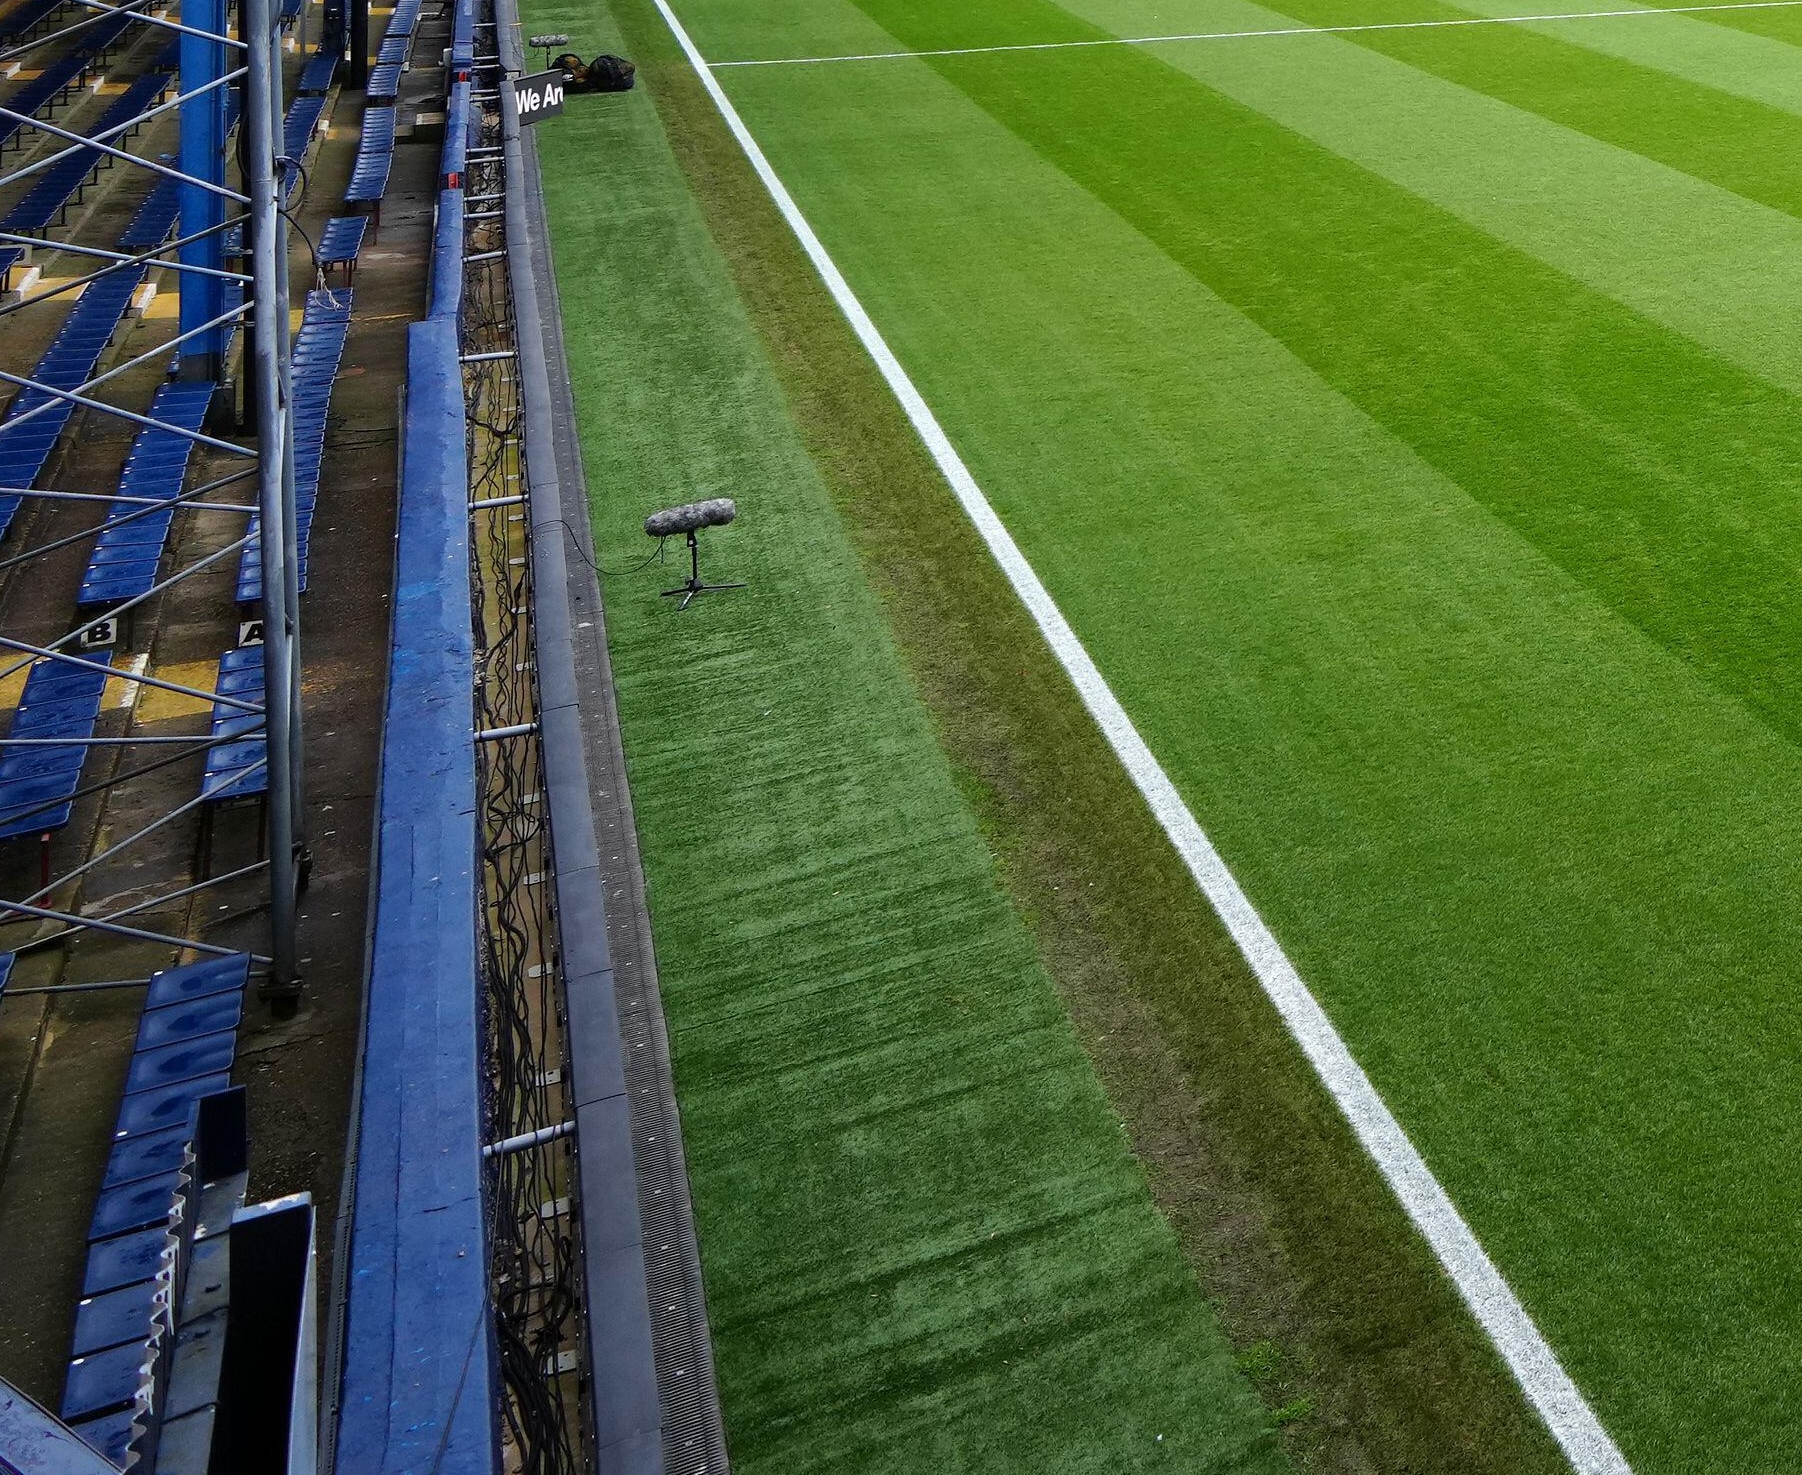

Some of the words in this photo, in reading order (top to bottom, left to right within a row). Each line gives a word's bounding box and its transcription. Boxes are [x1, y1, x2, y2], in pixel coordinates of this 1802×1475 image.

[515, 88, 541, 115] We
[87, 622, 112, 643] B
[243, 623, 264, 643] A
